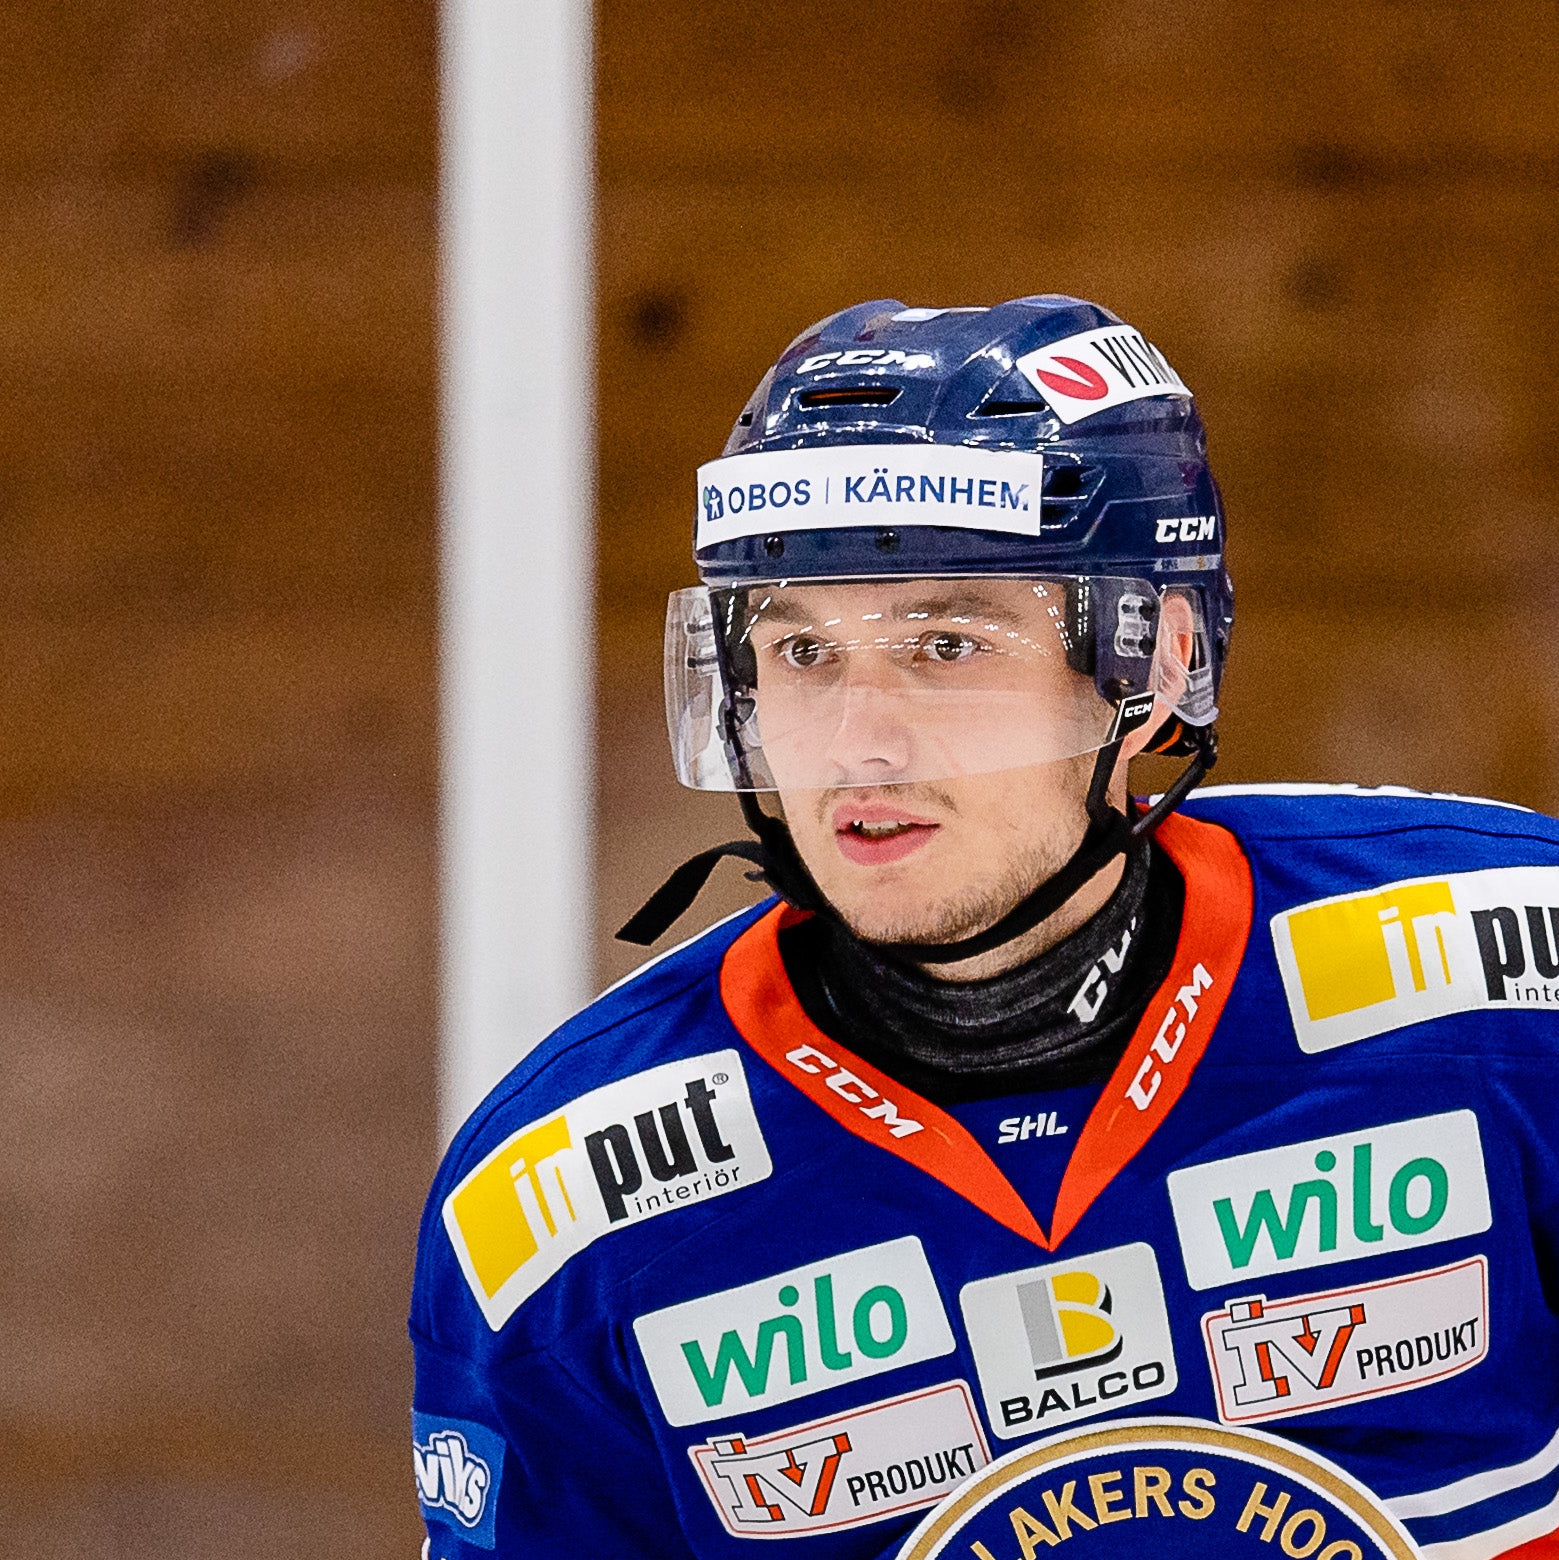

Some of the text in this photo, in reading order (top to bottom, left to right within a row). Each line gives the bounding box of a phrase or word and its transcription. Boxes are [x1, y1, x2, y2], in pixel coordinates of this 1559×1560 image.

[728, 467, 1030, 514] OBOS KÄRNHEM
[1155, 515, 1215, 543] CCM
[1123, 702, 1154, 717] CCM
[1124, 962, 1215, 1111] CCM
[785, 1043, 925, 1139] CCM
[997, 1111, 1069, 1144] SHL
[508, 1077, 737, 1251] input
[633, 1164, 742, 1215] interiör
[1212, 1142, 1450, 1270] wilo
[680, 1273, 910, 1408] wilo
[1356, 1316, 1480, 1380] PRODUKT
[999, 1360, 1167, 1428] BALCO
[846, 1442, 979, 1508] PRODUKT
